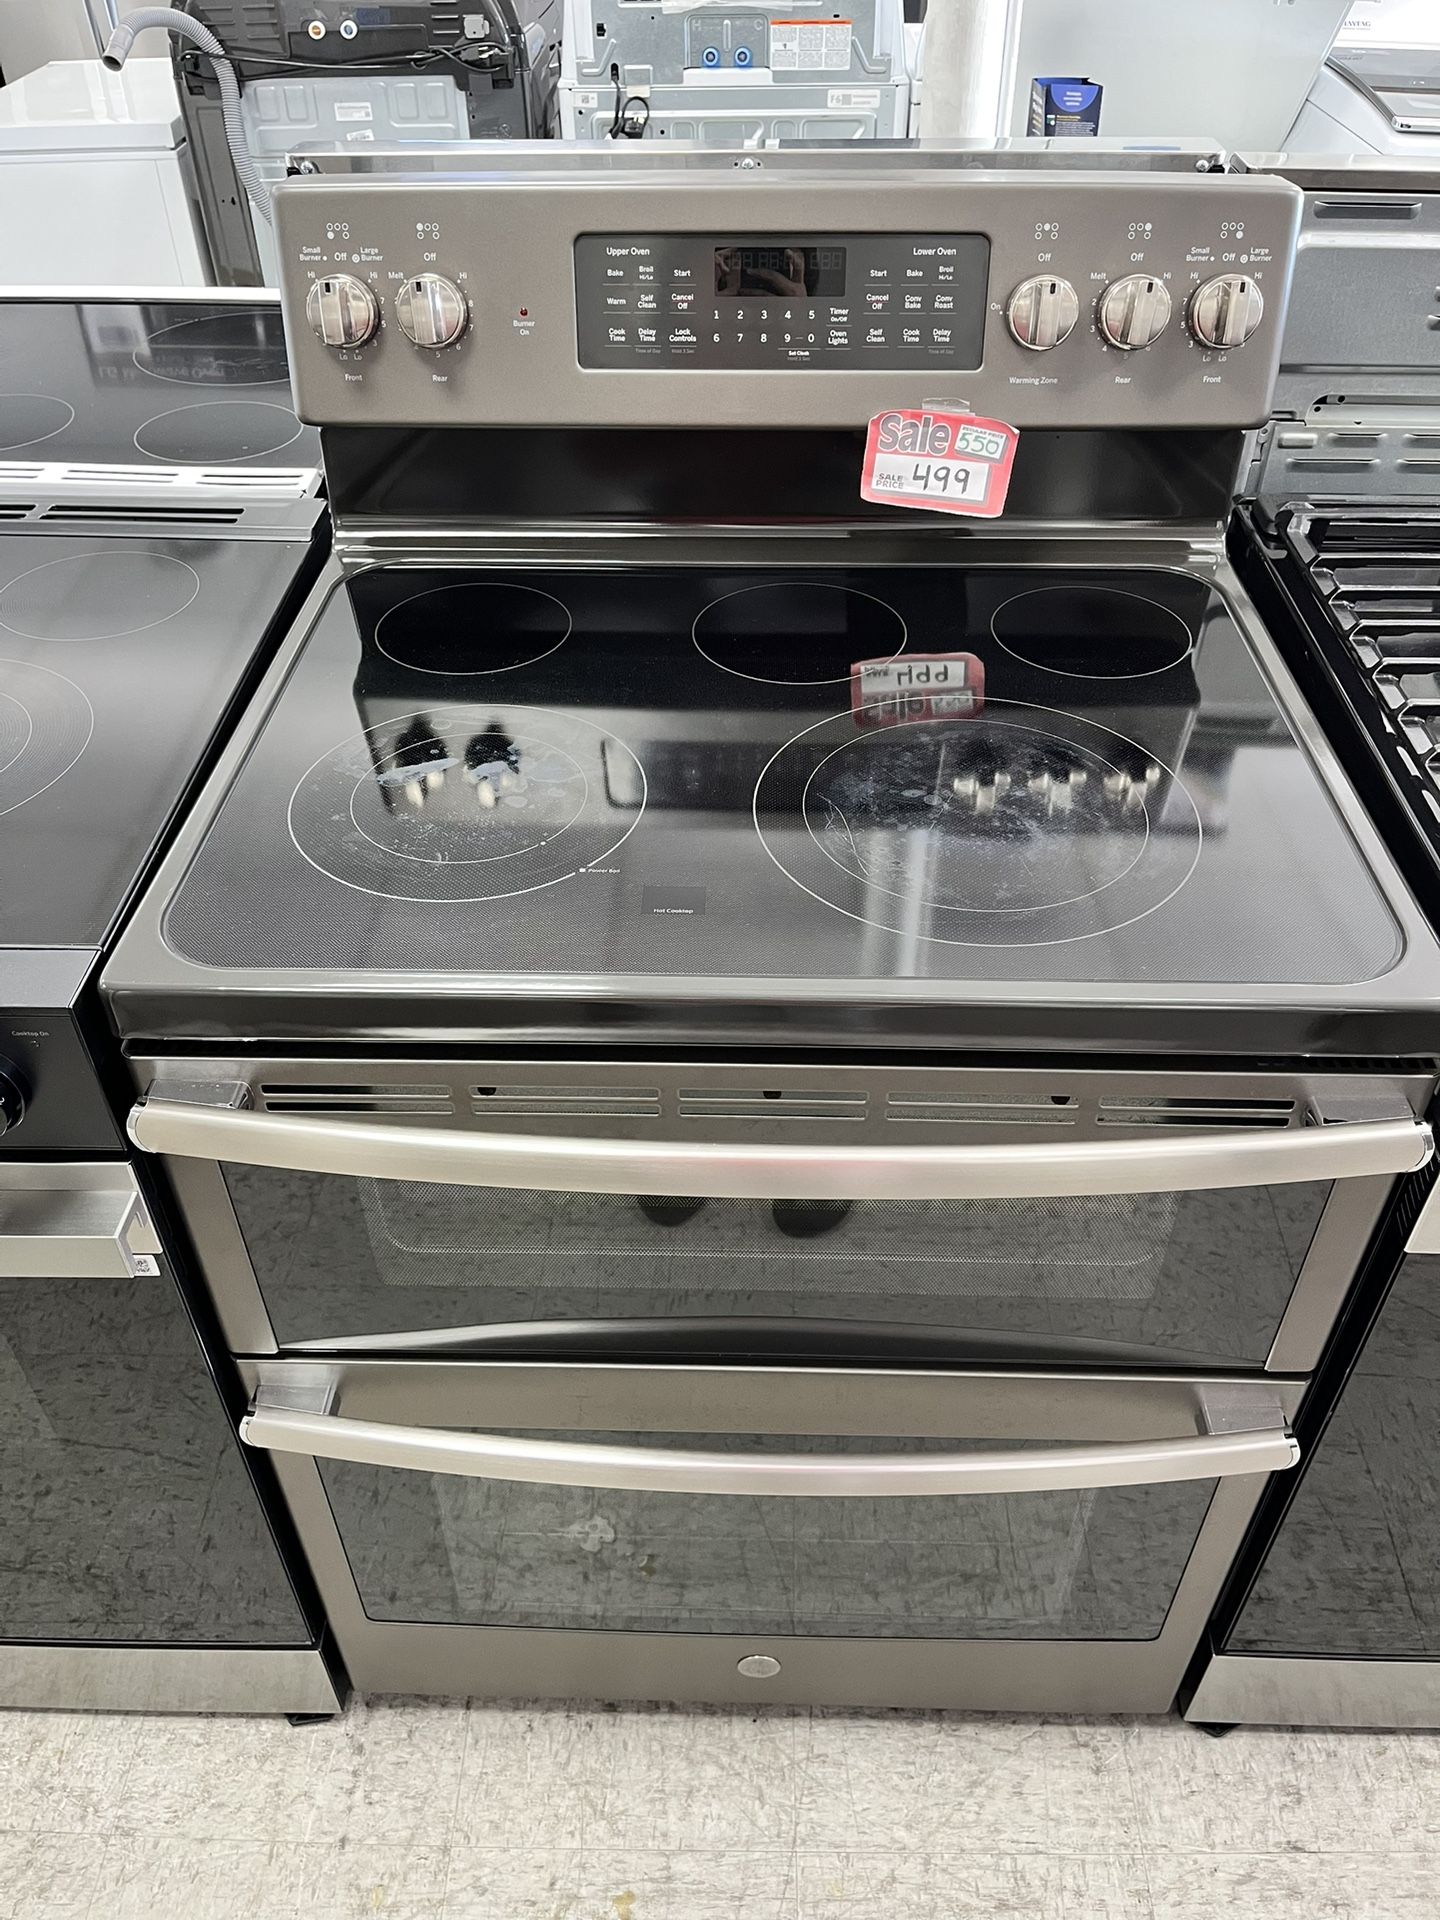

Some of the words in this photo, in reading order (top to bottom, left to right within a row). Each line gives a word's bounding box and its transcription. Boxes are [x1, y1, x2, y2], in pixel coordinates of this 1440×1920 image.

[302, 246, 321, 254] Small
[360, 246, 379, 255] Large
[606, 246, 630, 256] Upper
[630, 246, 650, 256] Oven
[913, 247, 937, 256] Lower
[937, 247, 957, 256] Oven
[1191, 246, 1210, 254] Small
[1250, 246, 1269, 256] Large
[334, 252, 347, 261] Off
[361, 254, 384, 262] Burner
[423, 252, 437, 261] Off
[1038, 253, 1052, 262] Off
[1130, 252, 1144, 261] Off
[1186, 254, 1209, 262] Burner
[1222, 252, 1236, 261] Off
[1249, 254, 1272, 262] Burner
[607, 269, 624, 277] Bake
[638, 265, 654, 273] Broil
[673, 269, 691, 277] Start
[870, 269, 887, 277] Start
[906, 269, 923, 277] Bake
[939, 265, 954, 273] Broil
[307, 271, 316, 279] Hi
[369, 271, 378, 279] Hi
[388, 271, 404, 279] Melt
[459, 272, 468, 280] Hi
[1090, 272, 1106, 280] Melt
[1190, 272, 1198, 280] Hi
[607, 297, 627, 305] Warm
[640, 293, 653, 302] Self
[671, 293, 694, 301] Cancel
[866, 293, 889, 301] Cancel
[904, 294, 922, 302] Conv
[935, 294, 954, 302] Conv
[637, 301, 657, 309] Clean
[677, 302, 688, 310] Off
[871, 302, 883, 310] Off
[714, 310, 720, 319] 1
[737, 310, 744, 319] 2
[760, 310, 768, 319] 3
[784, 310, 792, 319] 4
[808, 310, 815, 319] 5
[829, 307, 849, 315] Timer
[513, 320, 535, 328] Burner
[638, 328, 657, 336] Delay
[829, 329, 847, 337] Oven
[869, 328, 883, 336] Self
[902, 328, 920, 336] Cook
[932, 328, 952, 337] Delay
[713, 333, 720, 342] 6
[737, 333, 743, 342] 7
[760, 333, 767, 342] 8
[784, 333, 791, 342] 9
[807, 333, 815, 342] 0
[828, 337, 848, 346] Lights
[866, 335, 885, 343] Clean
[903, 335, 920, 343] Time
[933, 335, 950, 343] Time
[1009, 376, 1040, 385] Warming
[1040, 376, 1058, 385] Zone
[1115, 376, 1131, 384] Rear
[878, 413, 951, 456] Sale
[957, 432, 1000, 455] 550
[878, 473, 903, 482] SALE
[912, 464, 970, 494] 499
[876, 480, 904, 489] PRICE
